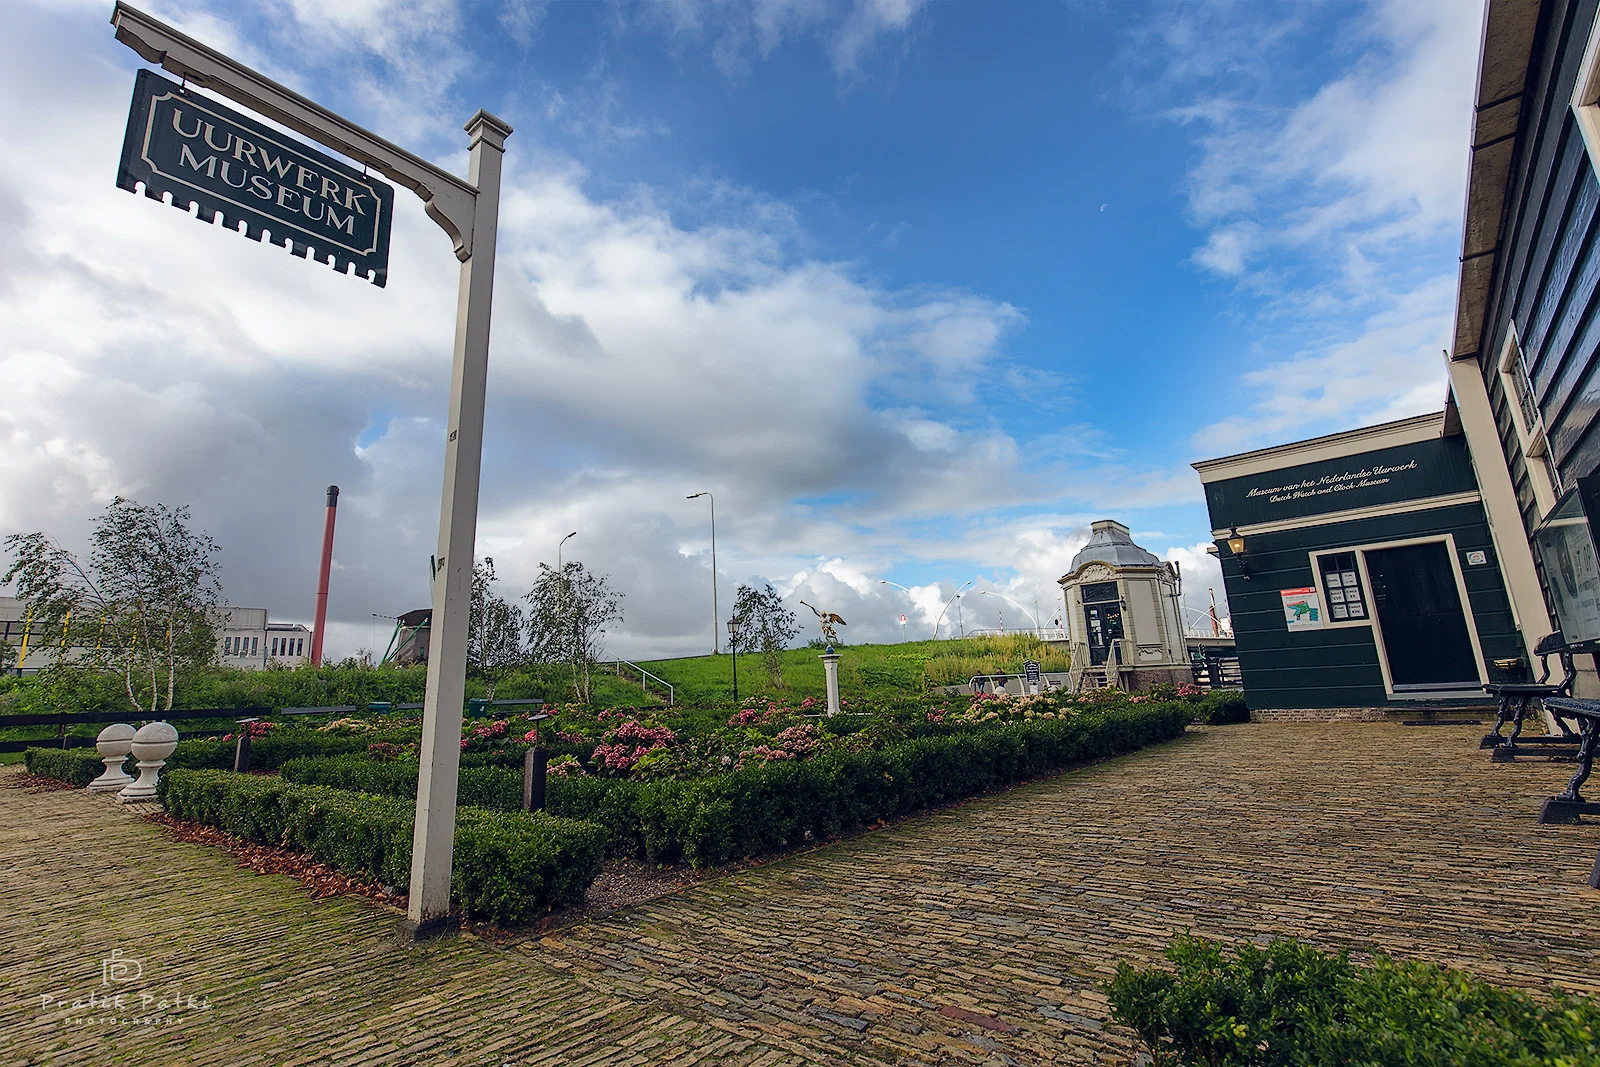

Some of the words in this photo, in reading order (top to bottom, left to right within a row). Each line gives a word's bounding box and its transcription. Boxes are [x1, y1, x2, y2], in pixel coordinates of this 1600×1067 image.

[172, 107, 367, 216] UURWERK
[178, 143, 355, 236] MUSEUM
[1246, 487, 1282, 498] Museum
[1283, 483, 1300, 491] van
[1301, 479, 1315, 488] het
[1316, 469, 1372, 484] Nederlandse
[1372, 459, 1417, 475] Uurwerk
[1269, 492, 1292, 503] Dutch
[1292, 488, 1316, 499] Watch
[1317, 486, 1333, 494] and
[1334, 481, 1355, 492] Clock
[1356, 478, 1390, 488] Museum
